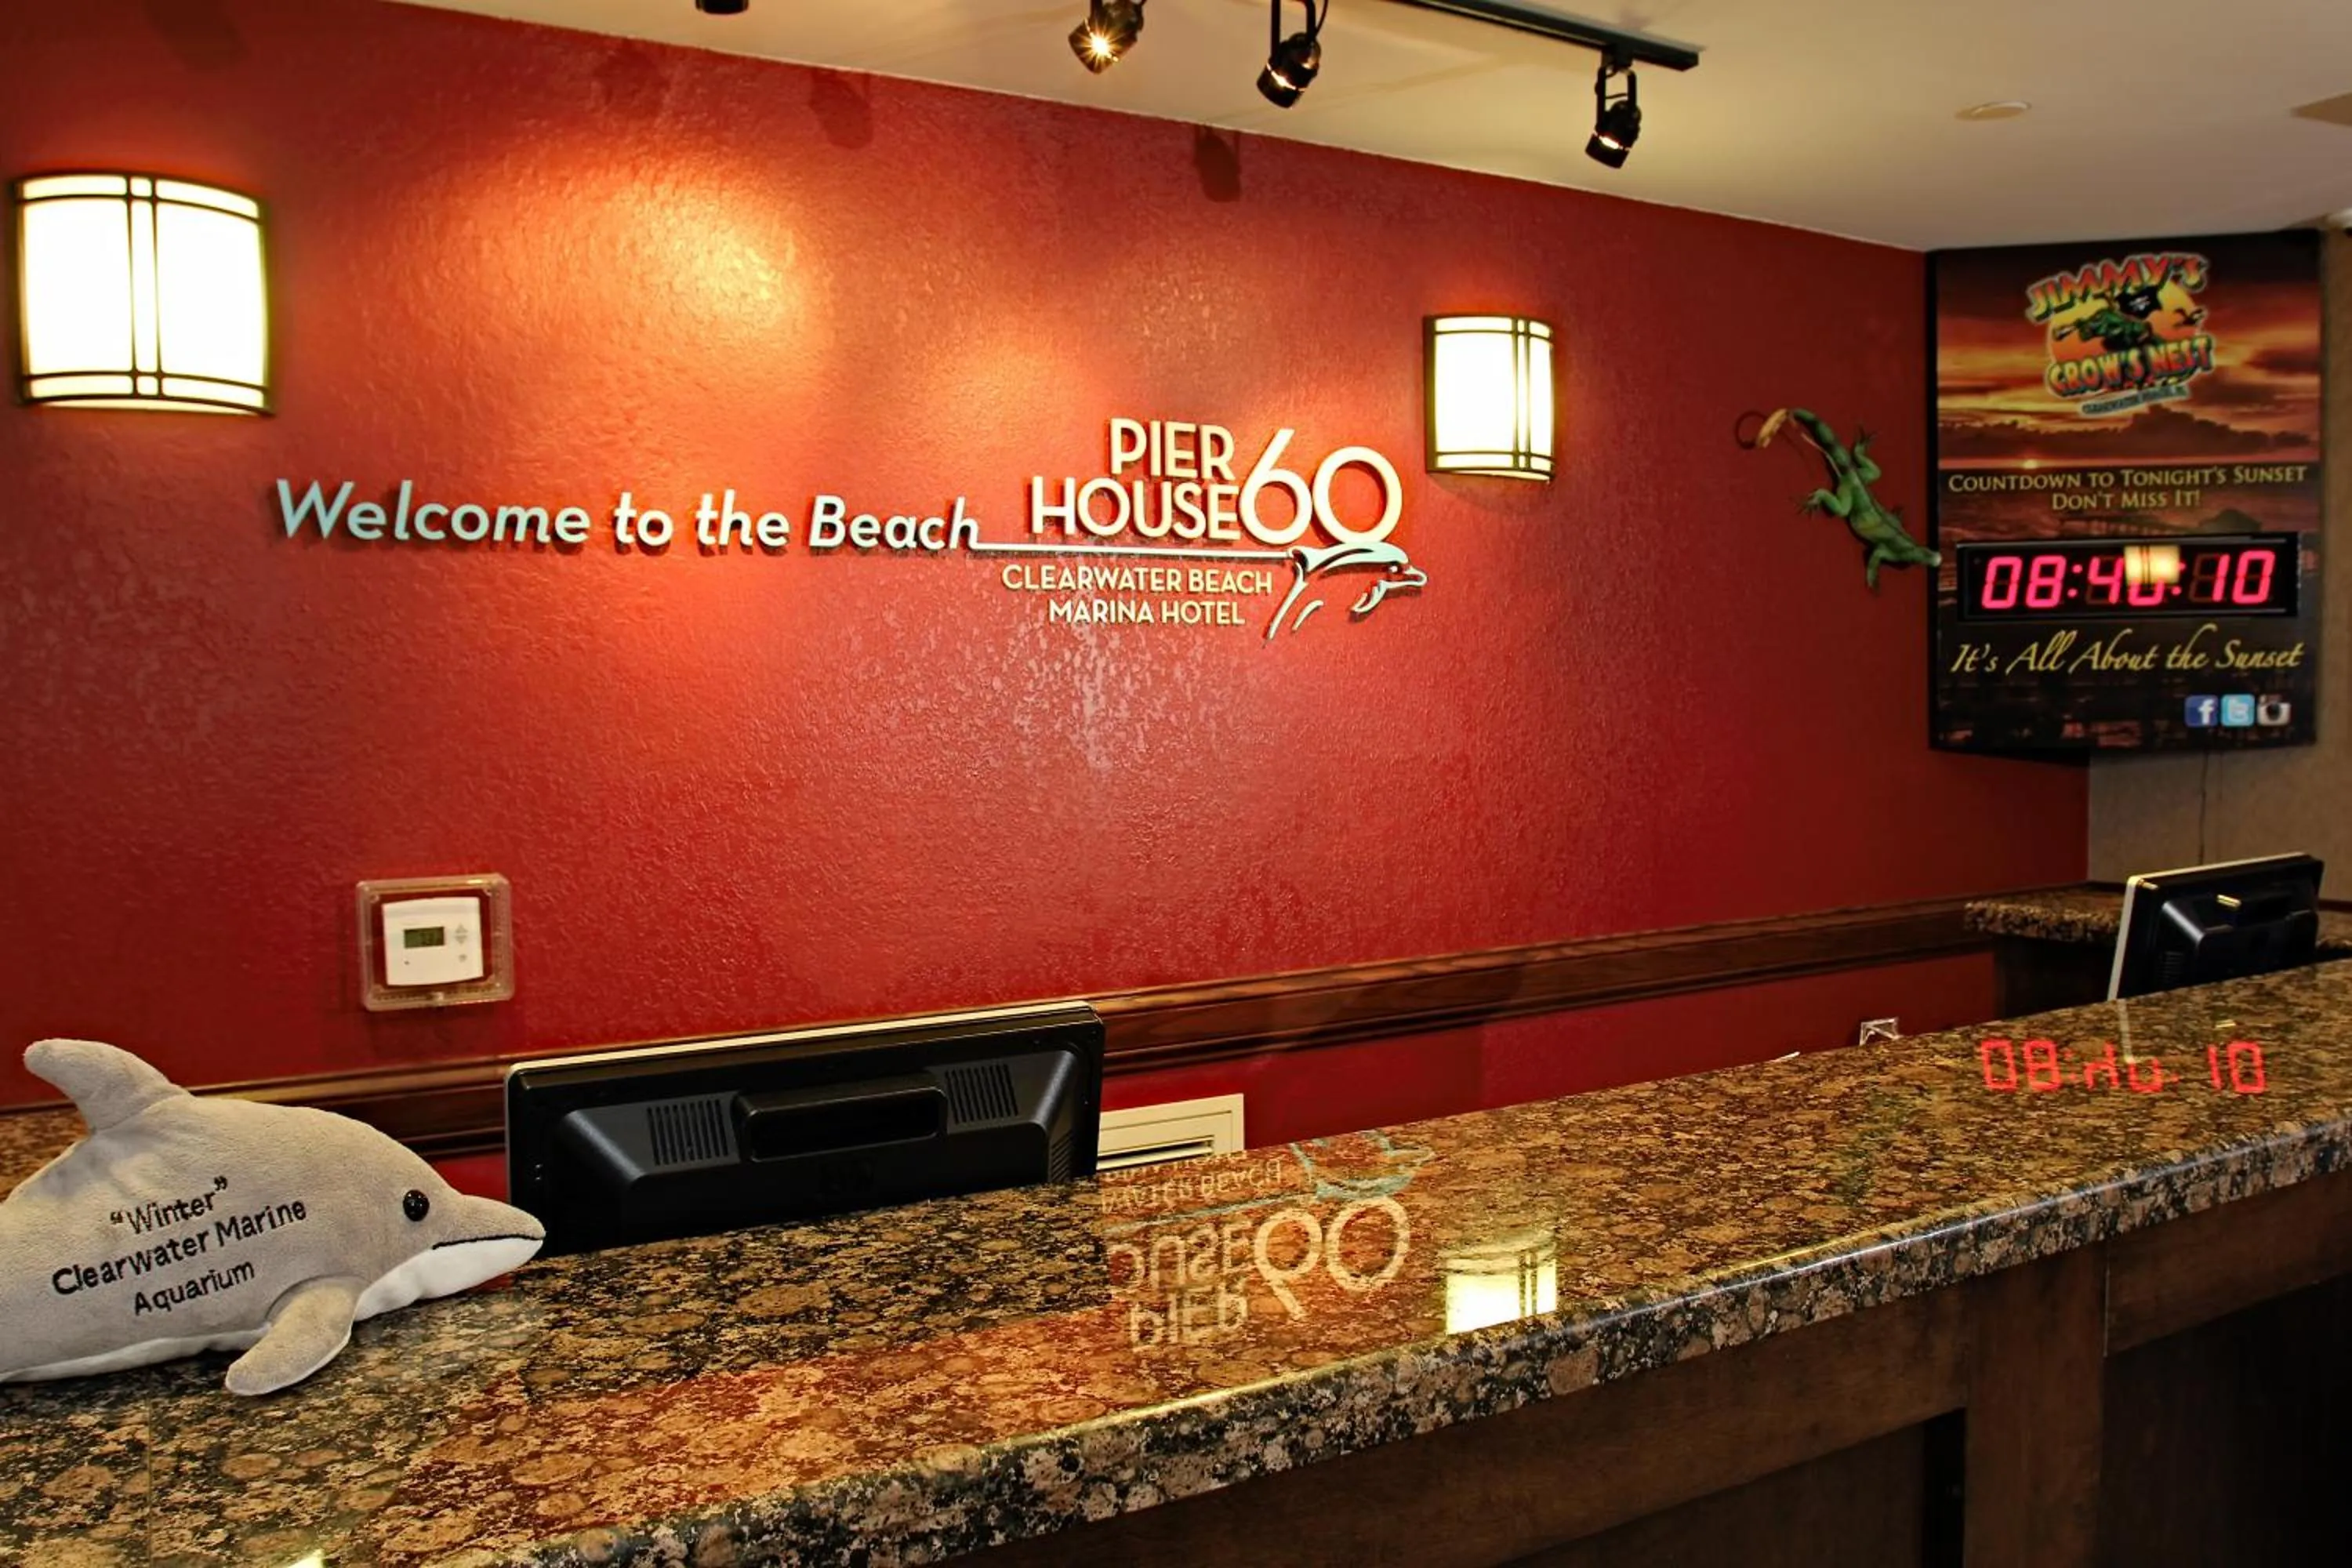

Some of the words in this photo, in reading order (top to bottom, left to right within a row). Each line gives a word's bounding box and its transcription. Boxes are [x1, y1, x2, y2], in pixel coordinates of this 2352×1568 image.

[1110, 418, 1235, 481] PIER
[1032, 476, 1242, 539] HOUSE
[1240, 429, 1403, 545] 60
[1948, 473, 2082, 493] COUNTDOWN
[2089, 472, 2115, 489] TO
[2120, 466, 2227, 488] TONIGHT'S
[2233, 465, 2308, 484] SUNSET
[2052, 492, 2113, 511] DON'T
[2122, 490, 2169, 508] MISS
[2175, 489, 2201, 507] IT!
[277, 480, 590, 543] Welcome
[613, 492, 673, 546] to
[695, 489, 790, 548] the
[808, 495, 982, 550] Beach
[1002, 564, 1182, 593] CLEARWATER
[1189, 570, 1272, 593] BEACH
[1049, 598, 1155, 624] MARINA
[1160, 601, 1246, 626] HOTEL
[1951, 644, 1998, 673] It's
[2005, 630, 2078, 674] All
[2068, 629, 2159, 674] About
[2165, 623, 2218, 670] the
[2216, 640, 2305, 669] Sunset
[214, 1200, 307, 1247] Marine
[134, 1261, 255, 1316] Aquarium
